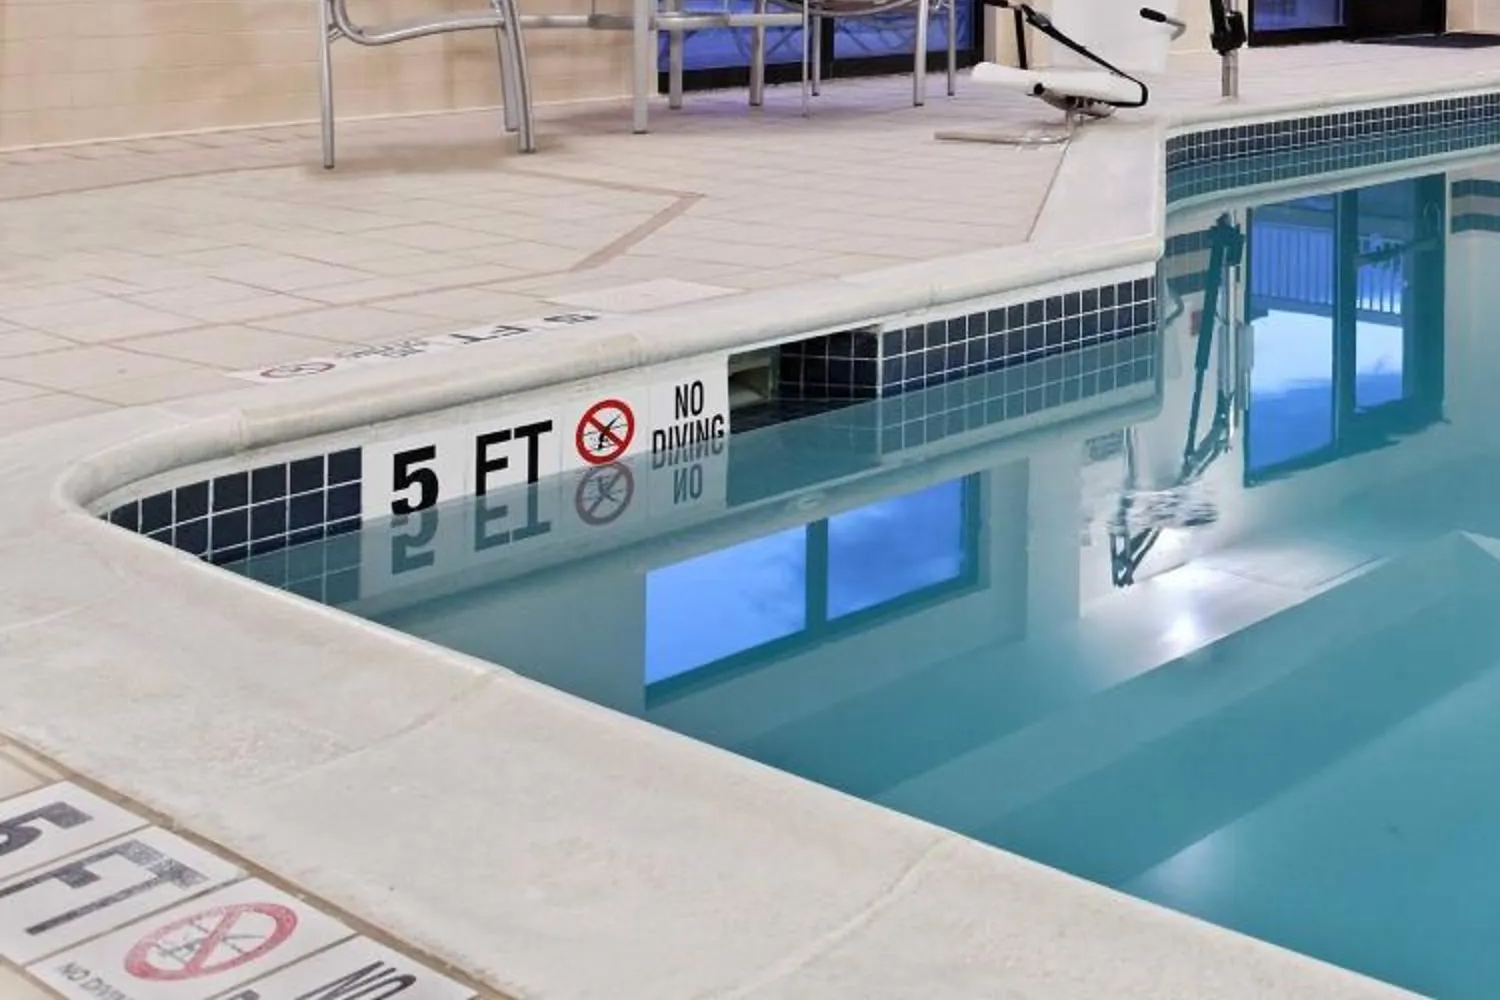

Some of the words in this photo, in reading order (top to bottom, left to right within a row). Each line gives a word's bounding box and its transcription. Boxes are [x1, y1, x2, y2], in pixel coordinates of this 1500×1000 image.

[652, 413, 724, 454] DIVING
[675, 380, 704, 420] NO
[391, 445, 439, 516] 5
[475, 420, 553, 496] FT
[0, 838, 208, 936] FT
